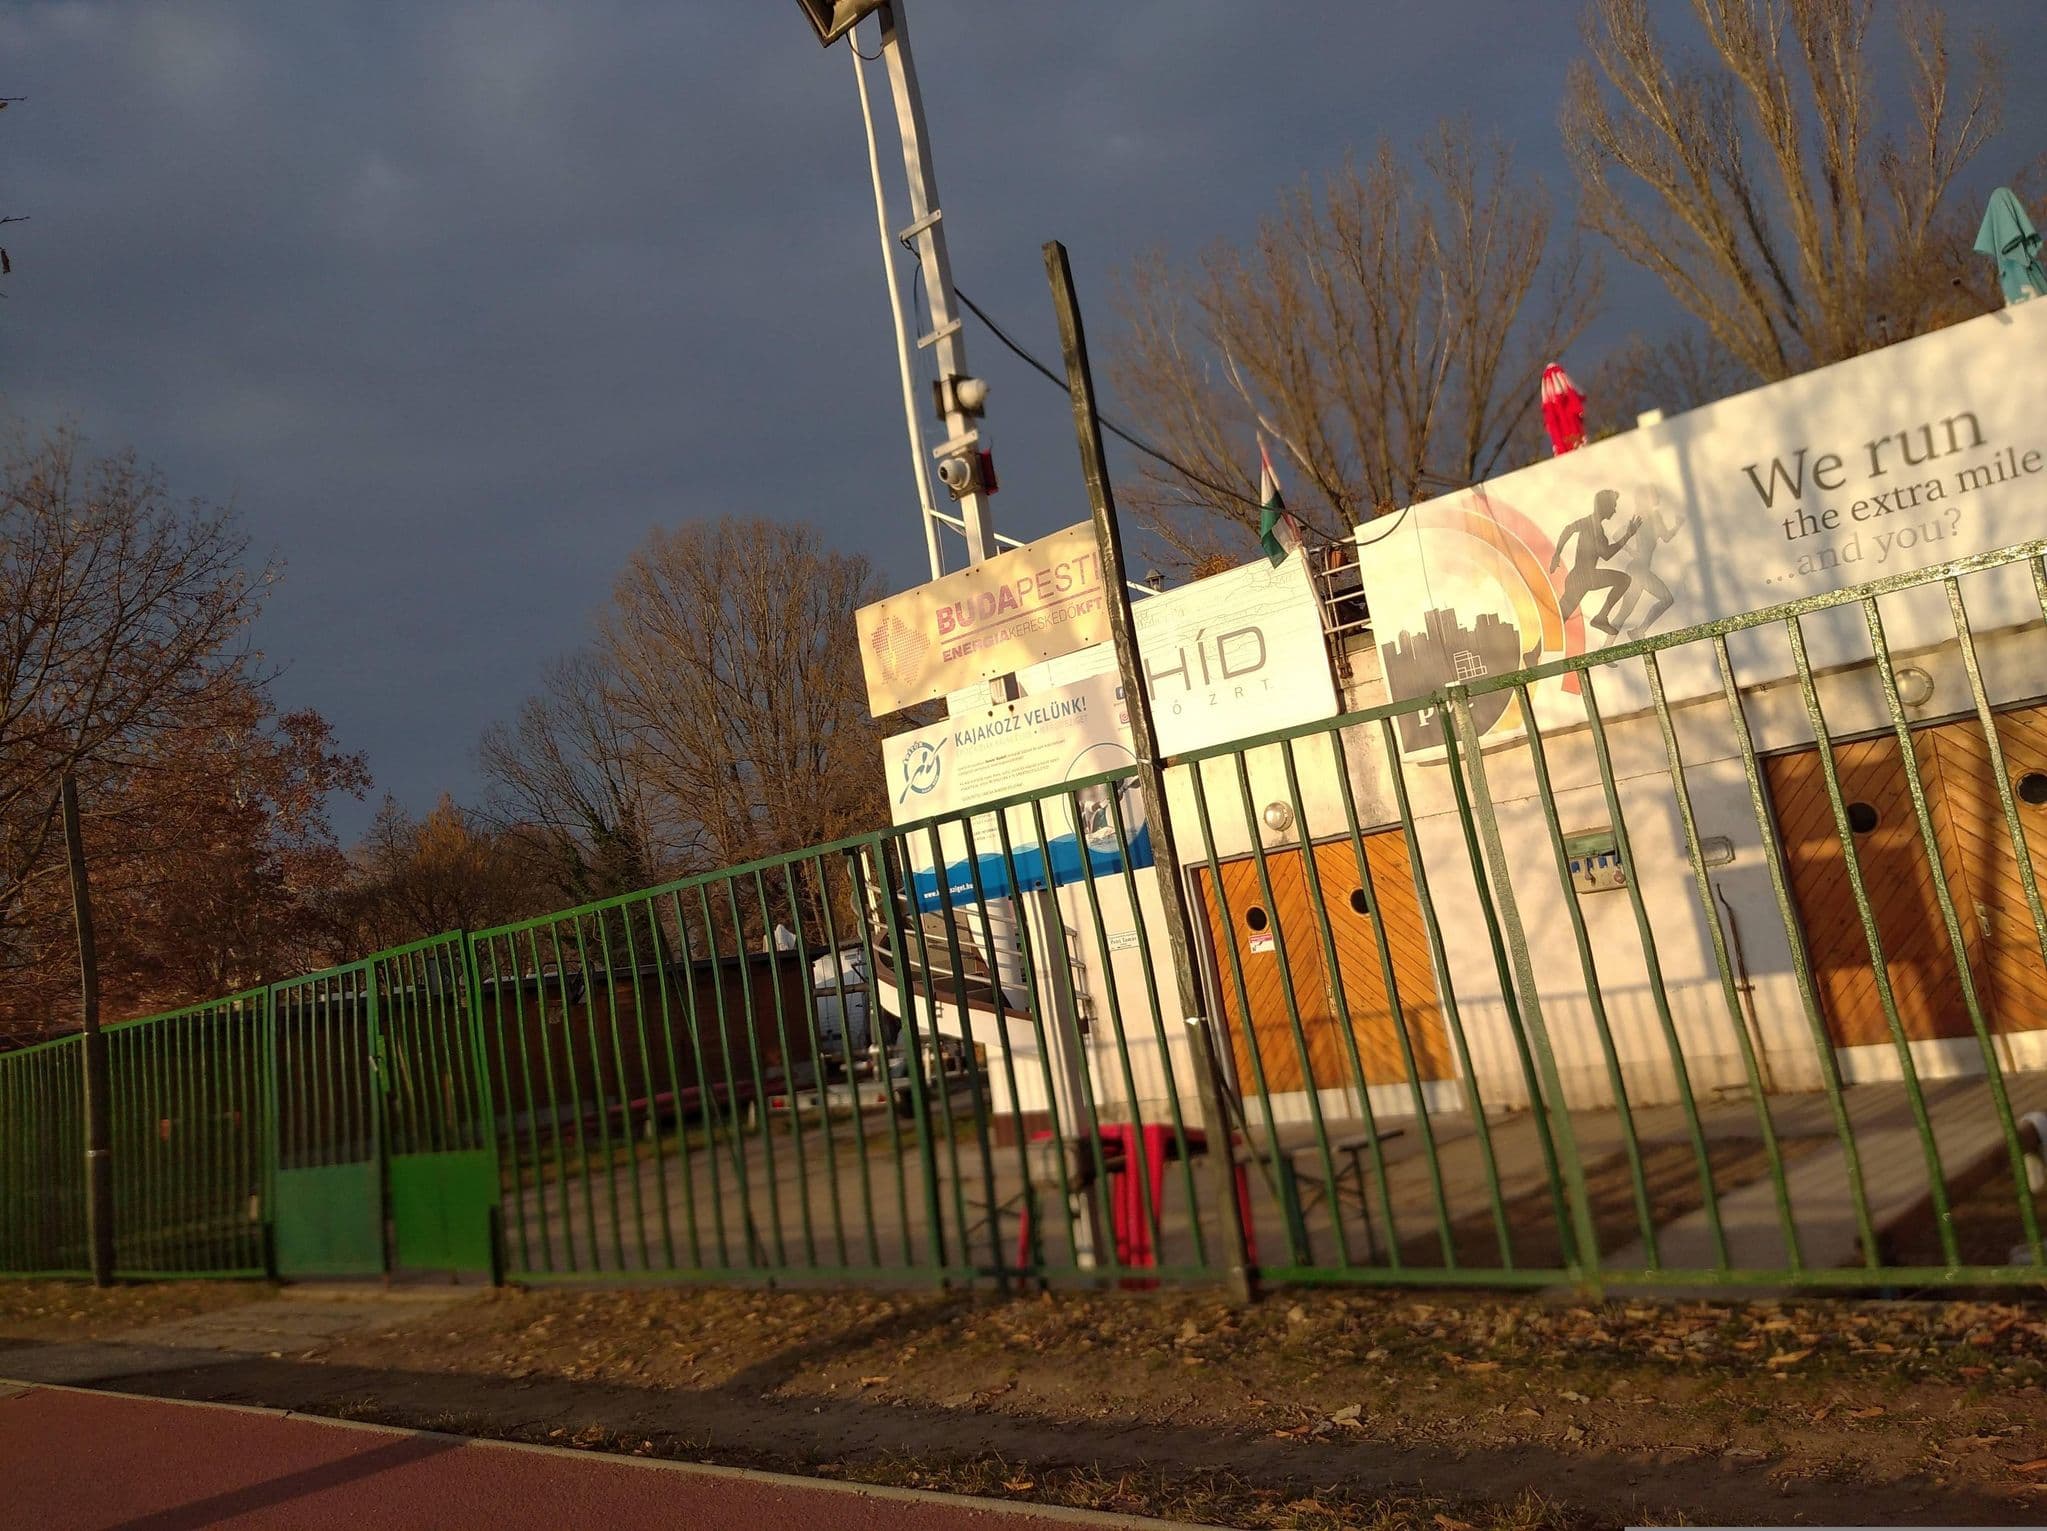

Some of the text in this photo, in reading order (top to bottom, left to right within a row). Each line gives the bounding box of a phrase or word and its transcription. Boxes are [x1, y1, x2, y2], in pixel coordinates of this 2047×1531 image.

[1741, 410, 1987, 509] We run
[1783, 447, 2044, 541] the extra mile
[1873, 508, 1962, 564] you?
[936, 552, 1099, 635] BUDAPESTI
[1144, 626, 1266, 701] HÍD
[954, 716, 1021, 748] KAJAKOZZ
[1024, 696, 1087, 727] VELÜNK!
